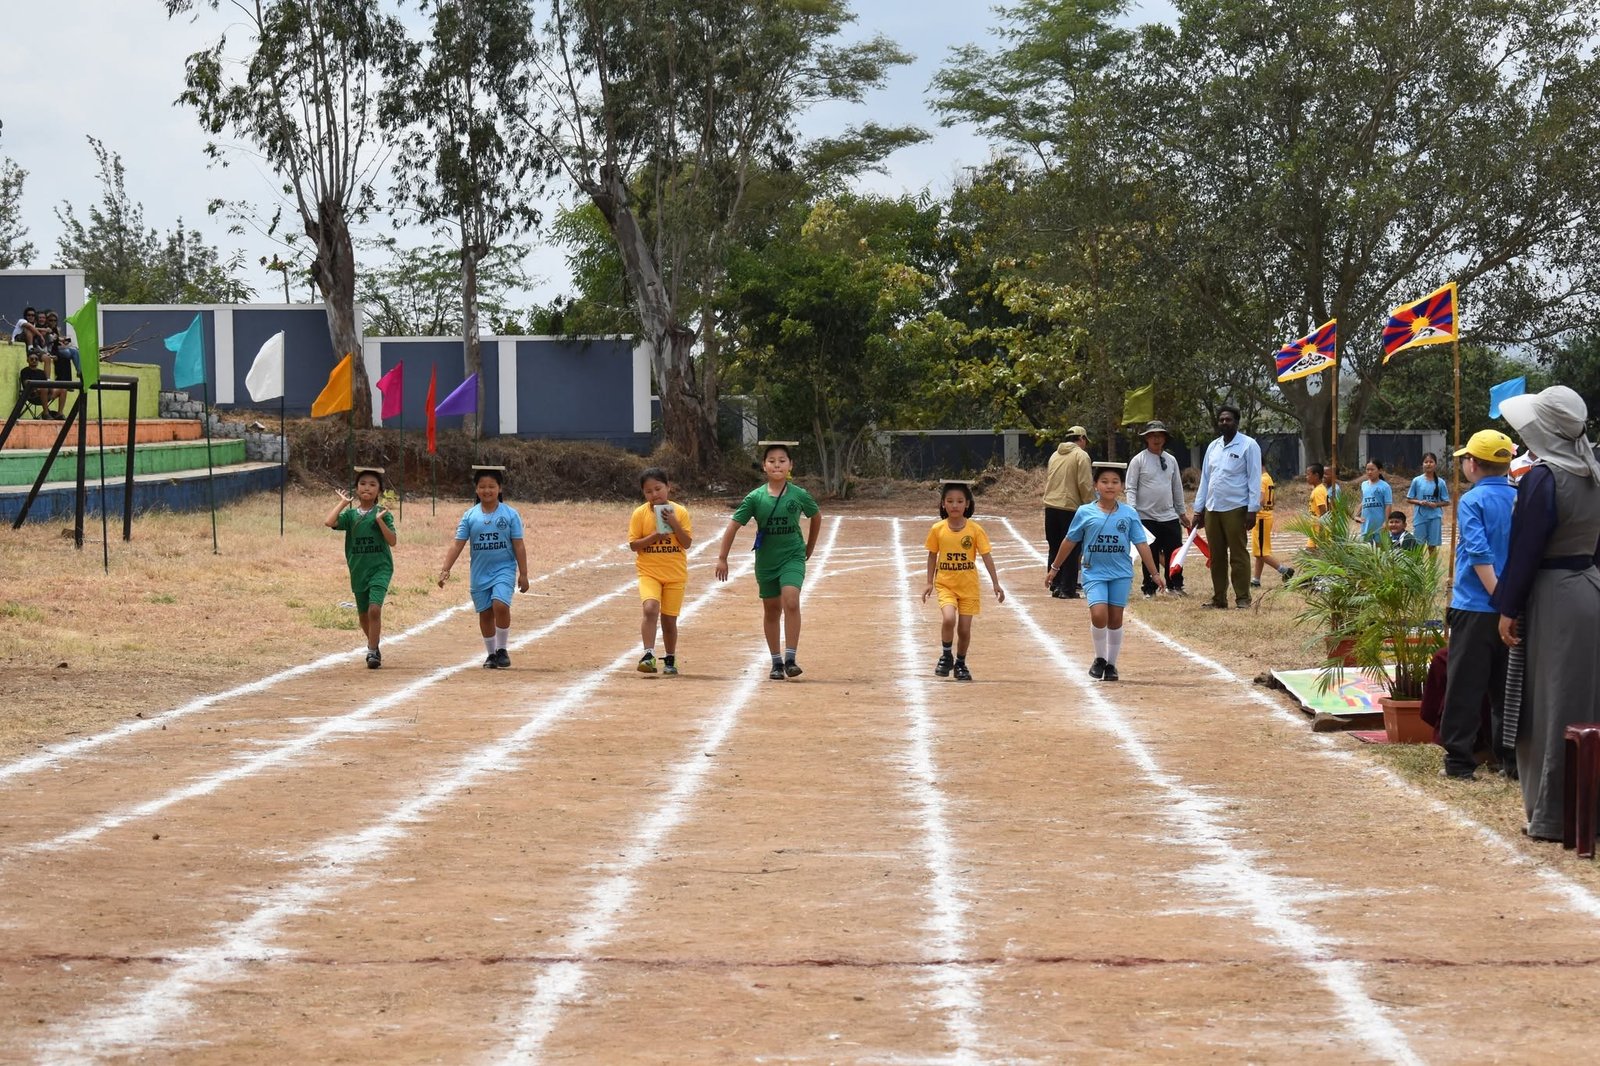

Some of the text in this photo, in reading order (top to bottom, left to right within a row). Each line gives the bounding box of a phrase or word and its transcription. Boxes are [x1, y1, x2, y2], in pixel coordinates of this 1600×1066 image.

[479, 532, 499, 541] STS
[1097, 534, 1119, 544] STS
[946, 552, 968, 561] STS
